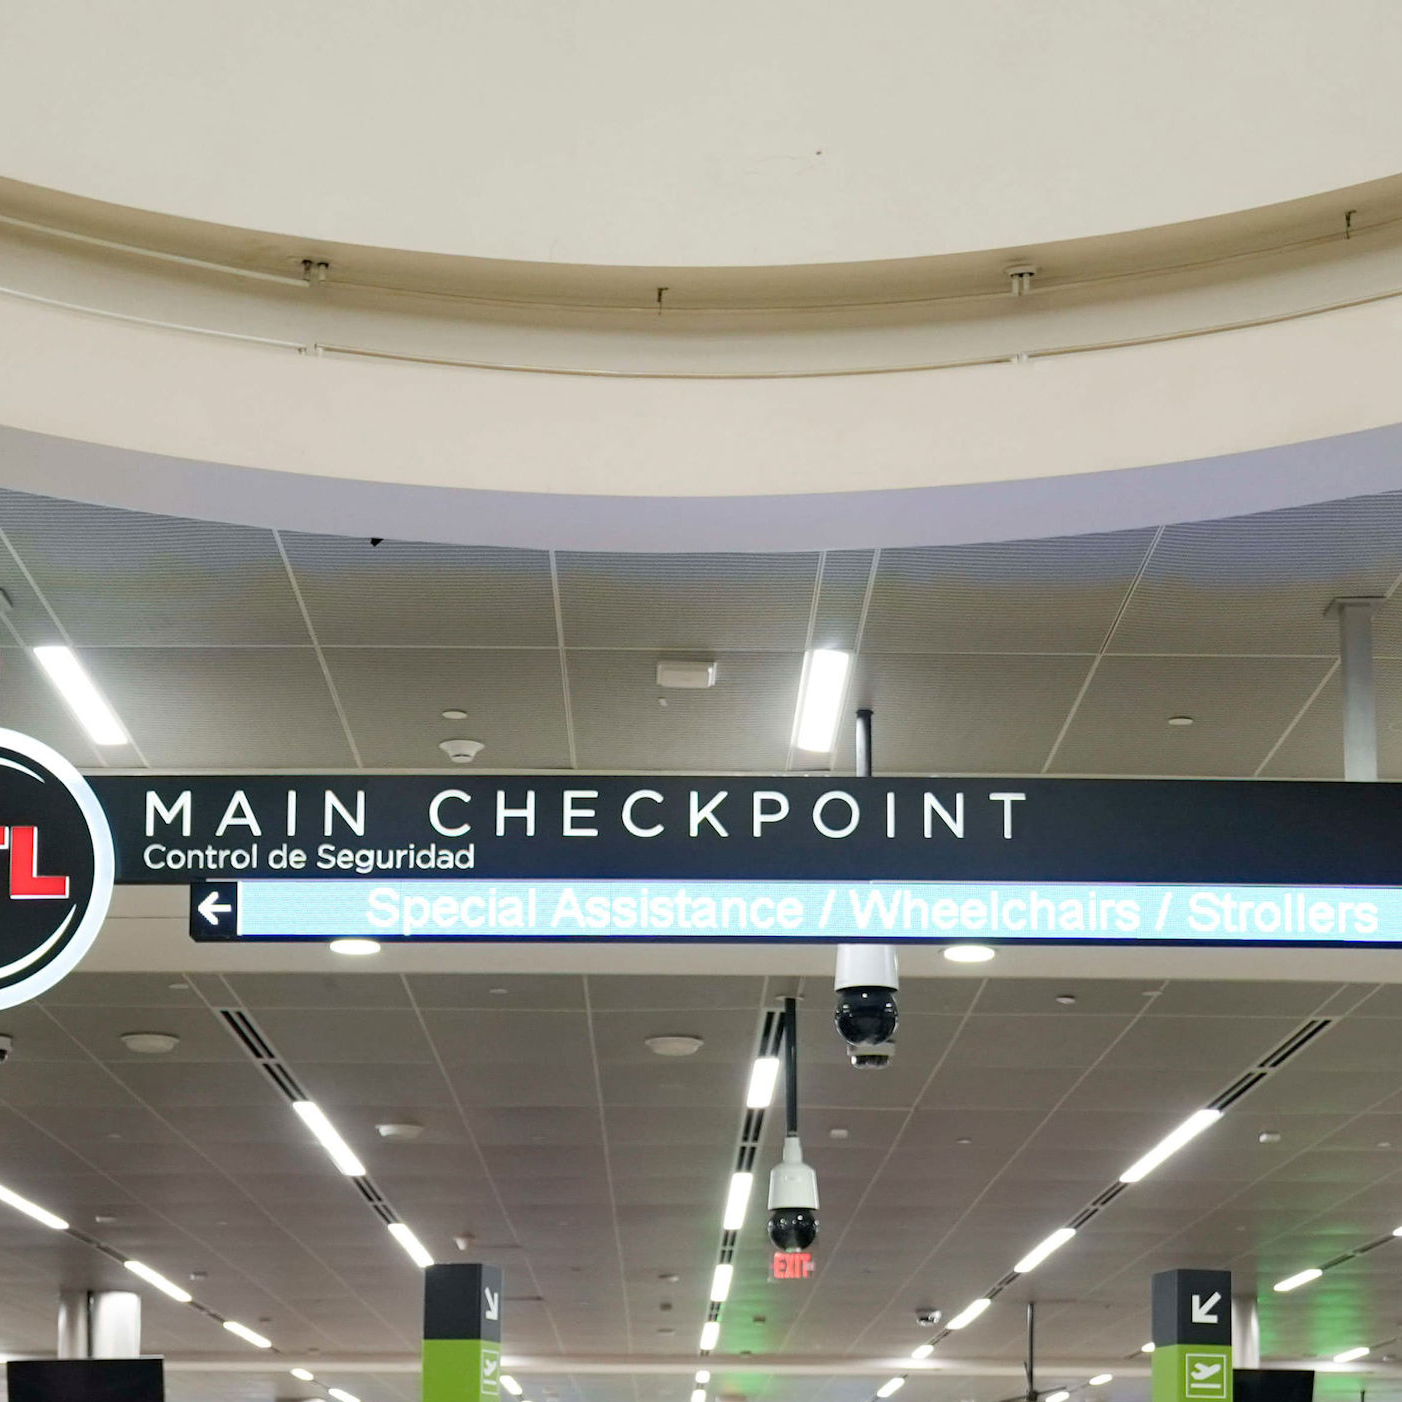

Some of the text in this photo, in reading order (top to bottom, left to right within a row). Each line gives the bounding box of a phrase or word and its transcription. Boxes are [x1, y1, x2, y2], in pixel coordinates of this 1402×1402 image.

[146, 788, 1026, 839] MAIN CHECKPOINT
[144, 843, 475, 874] Control de Seguridad
[366, 887, 1379, 934] Special Assistance / Wheelchairs / Strollers
[774, 1252, 812, 1279] EXIT
